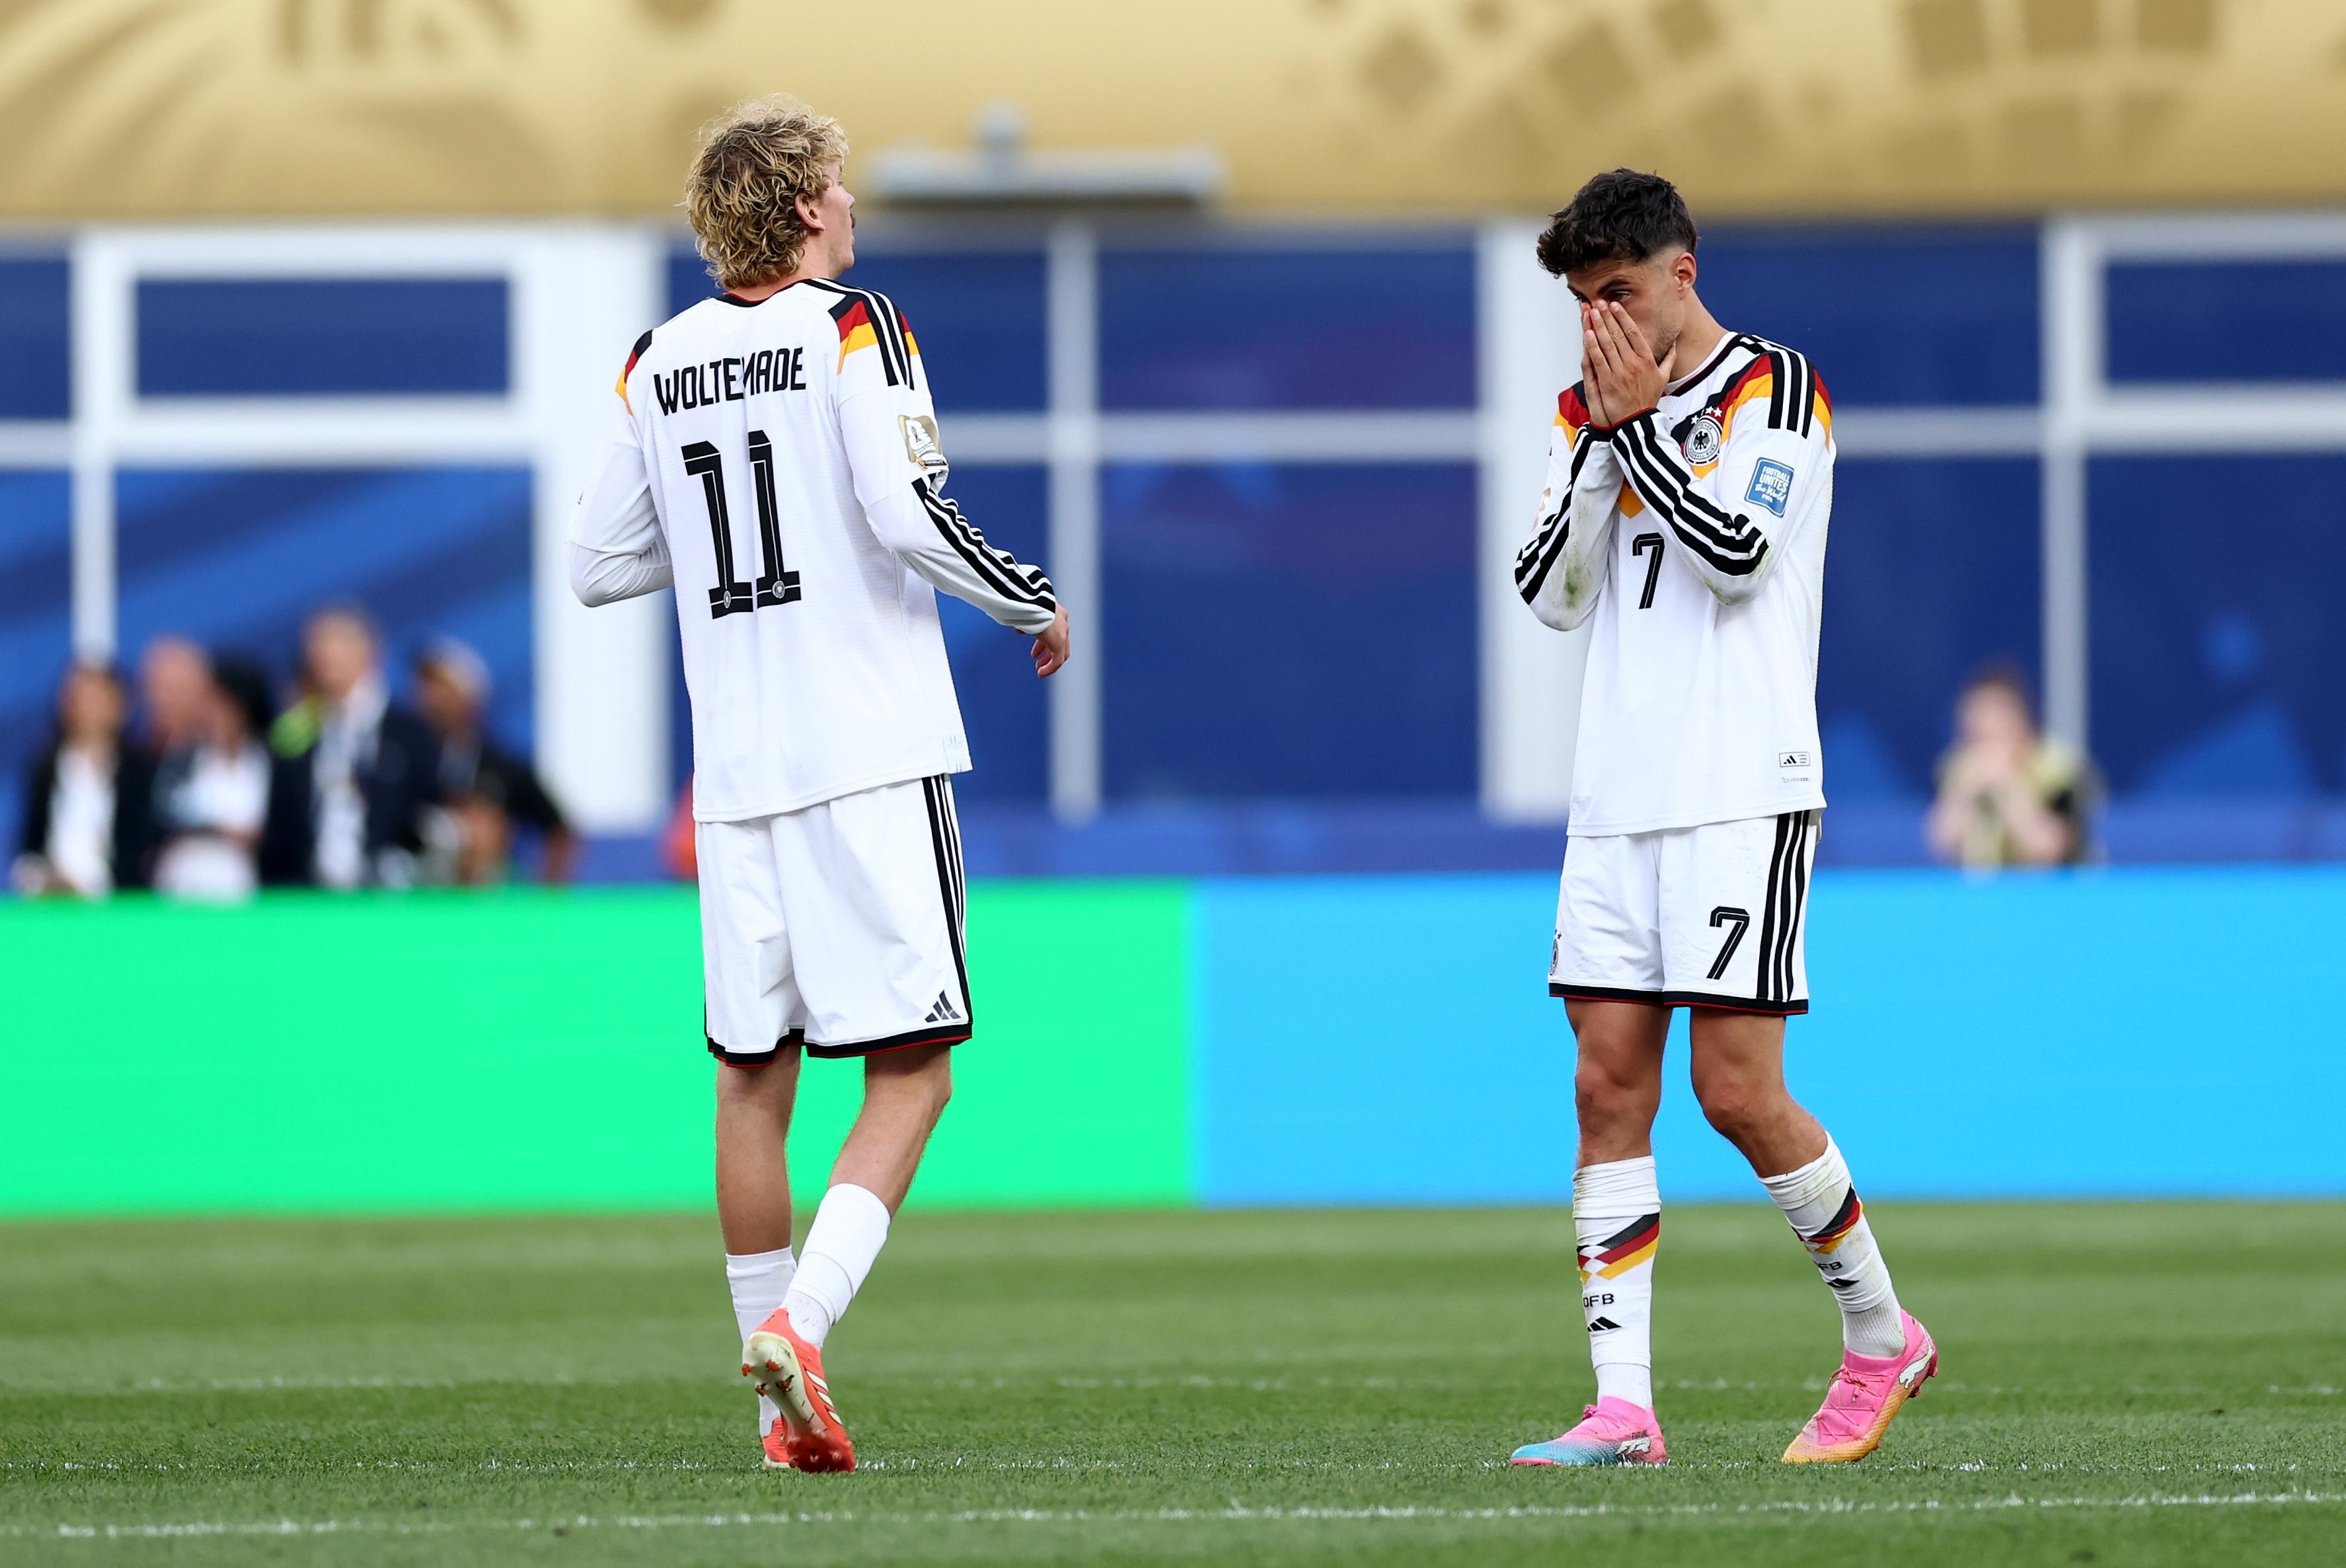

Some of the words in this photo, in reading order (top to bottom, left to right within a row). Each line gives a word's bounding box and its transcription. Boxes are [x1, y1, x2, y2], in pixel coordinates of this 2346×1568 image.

[1759, 473, 1789, 493] UNITES
[1762, 467, 1790, 483] FOOTBALL
[681, 429, 802, 619] 11
[1632, 533, 1665, 609] 7
[1706, 906, 1750, 980] 7
[1813, 1258, 1843, 1271] FB
[1583, 1293, 1614, 1307] DFB
